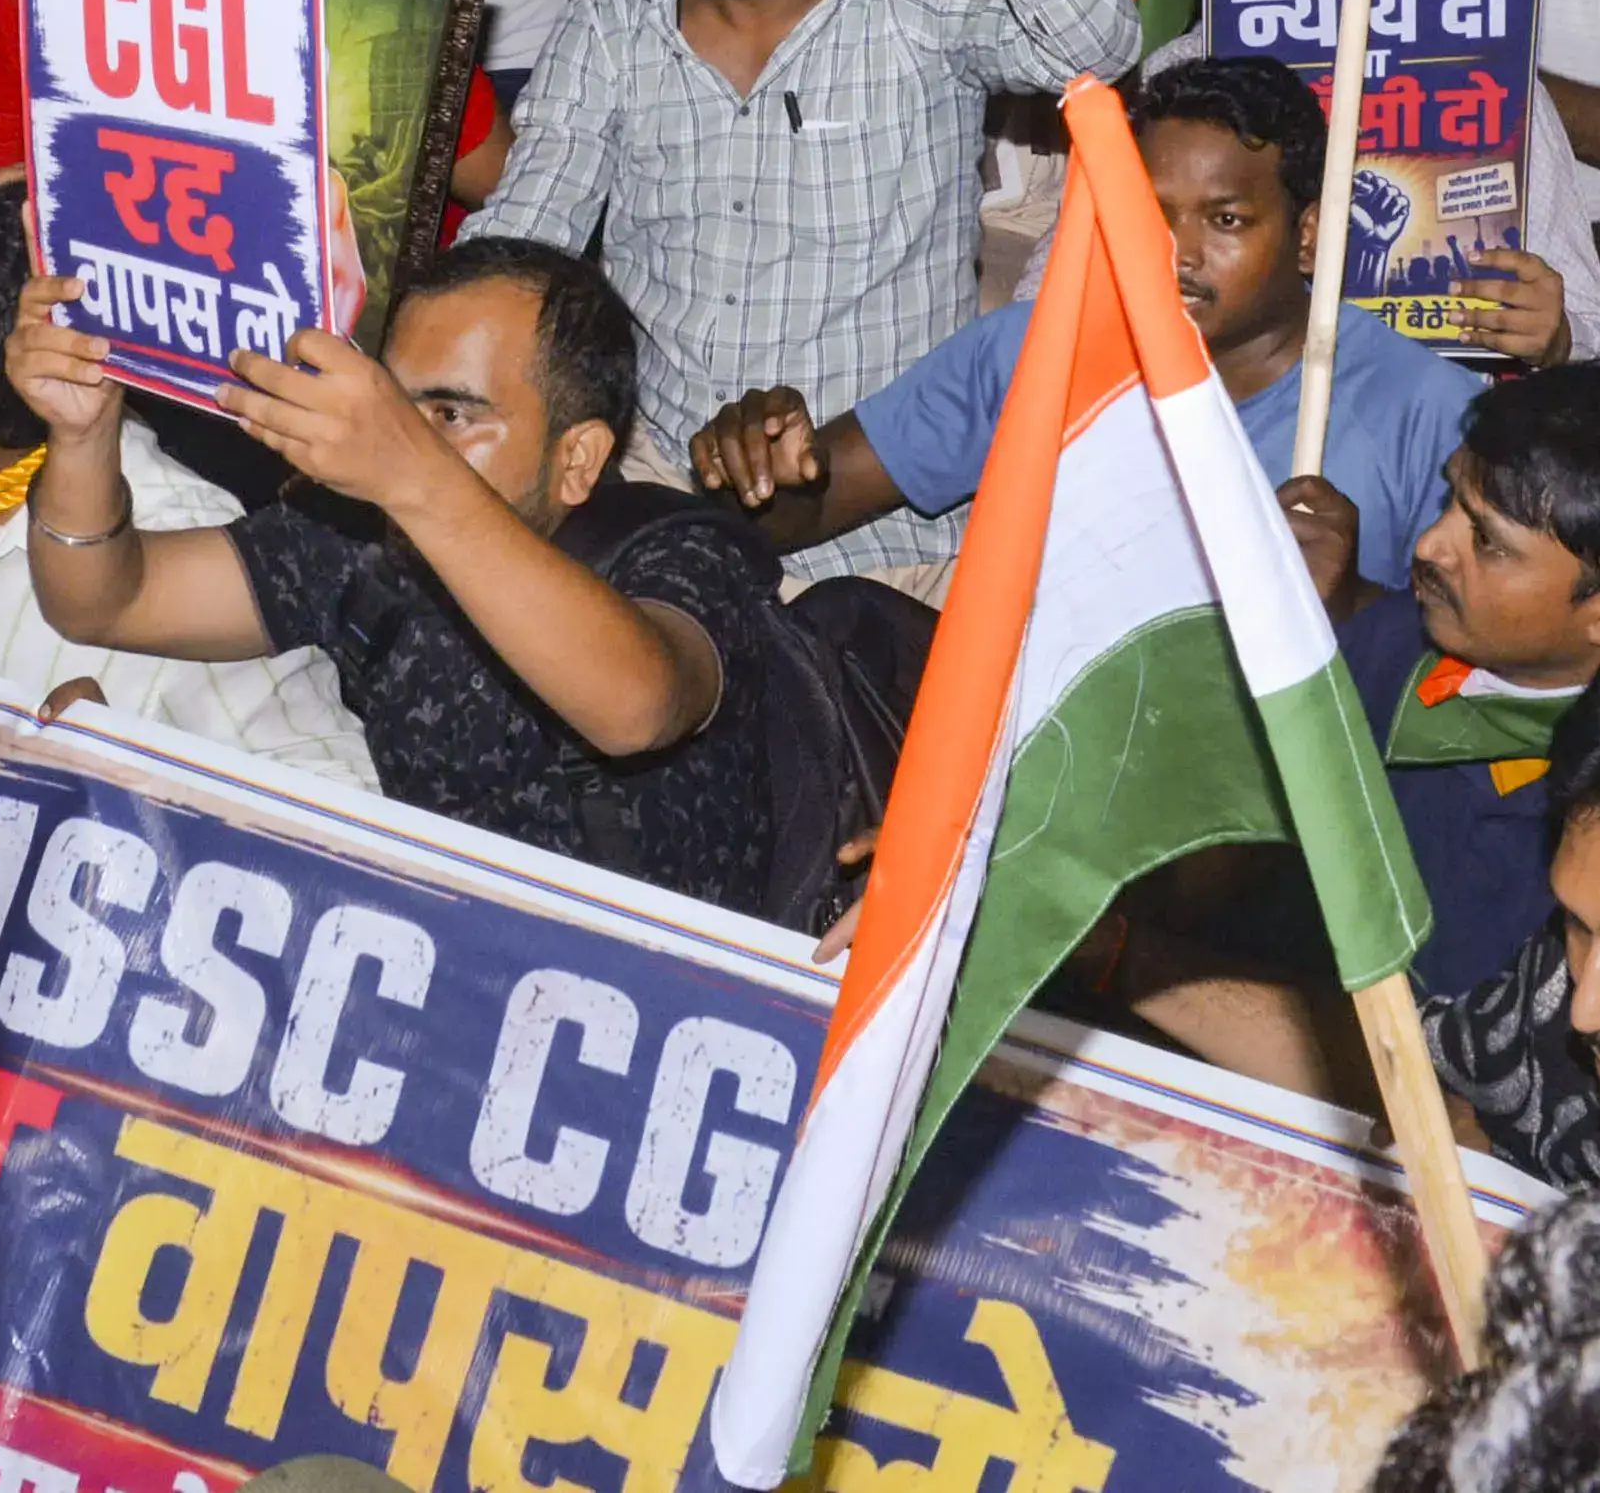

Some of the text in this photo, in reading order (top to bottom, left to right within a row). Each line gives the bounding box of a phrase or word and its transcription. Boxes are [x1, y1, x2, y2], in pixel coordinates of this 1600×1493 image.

[1433, 70, 1509, 147] दो
[96, 126, 236, 273] रद्द
[69, 237, 302, 367] वापस लो
[468, 966, 850, 1291] CG
[81, 1111, 742, 1493] वापस
